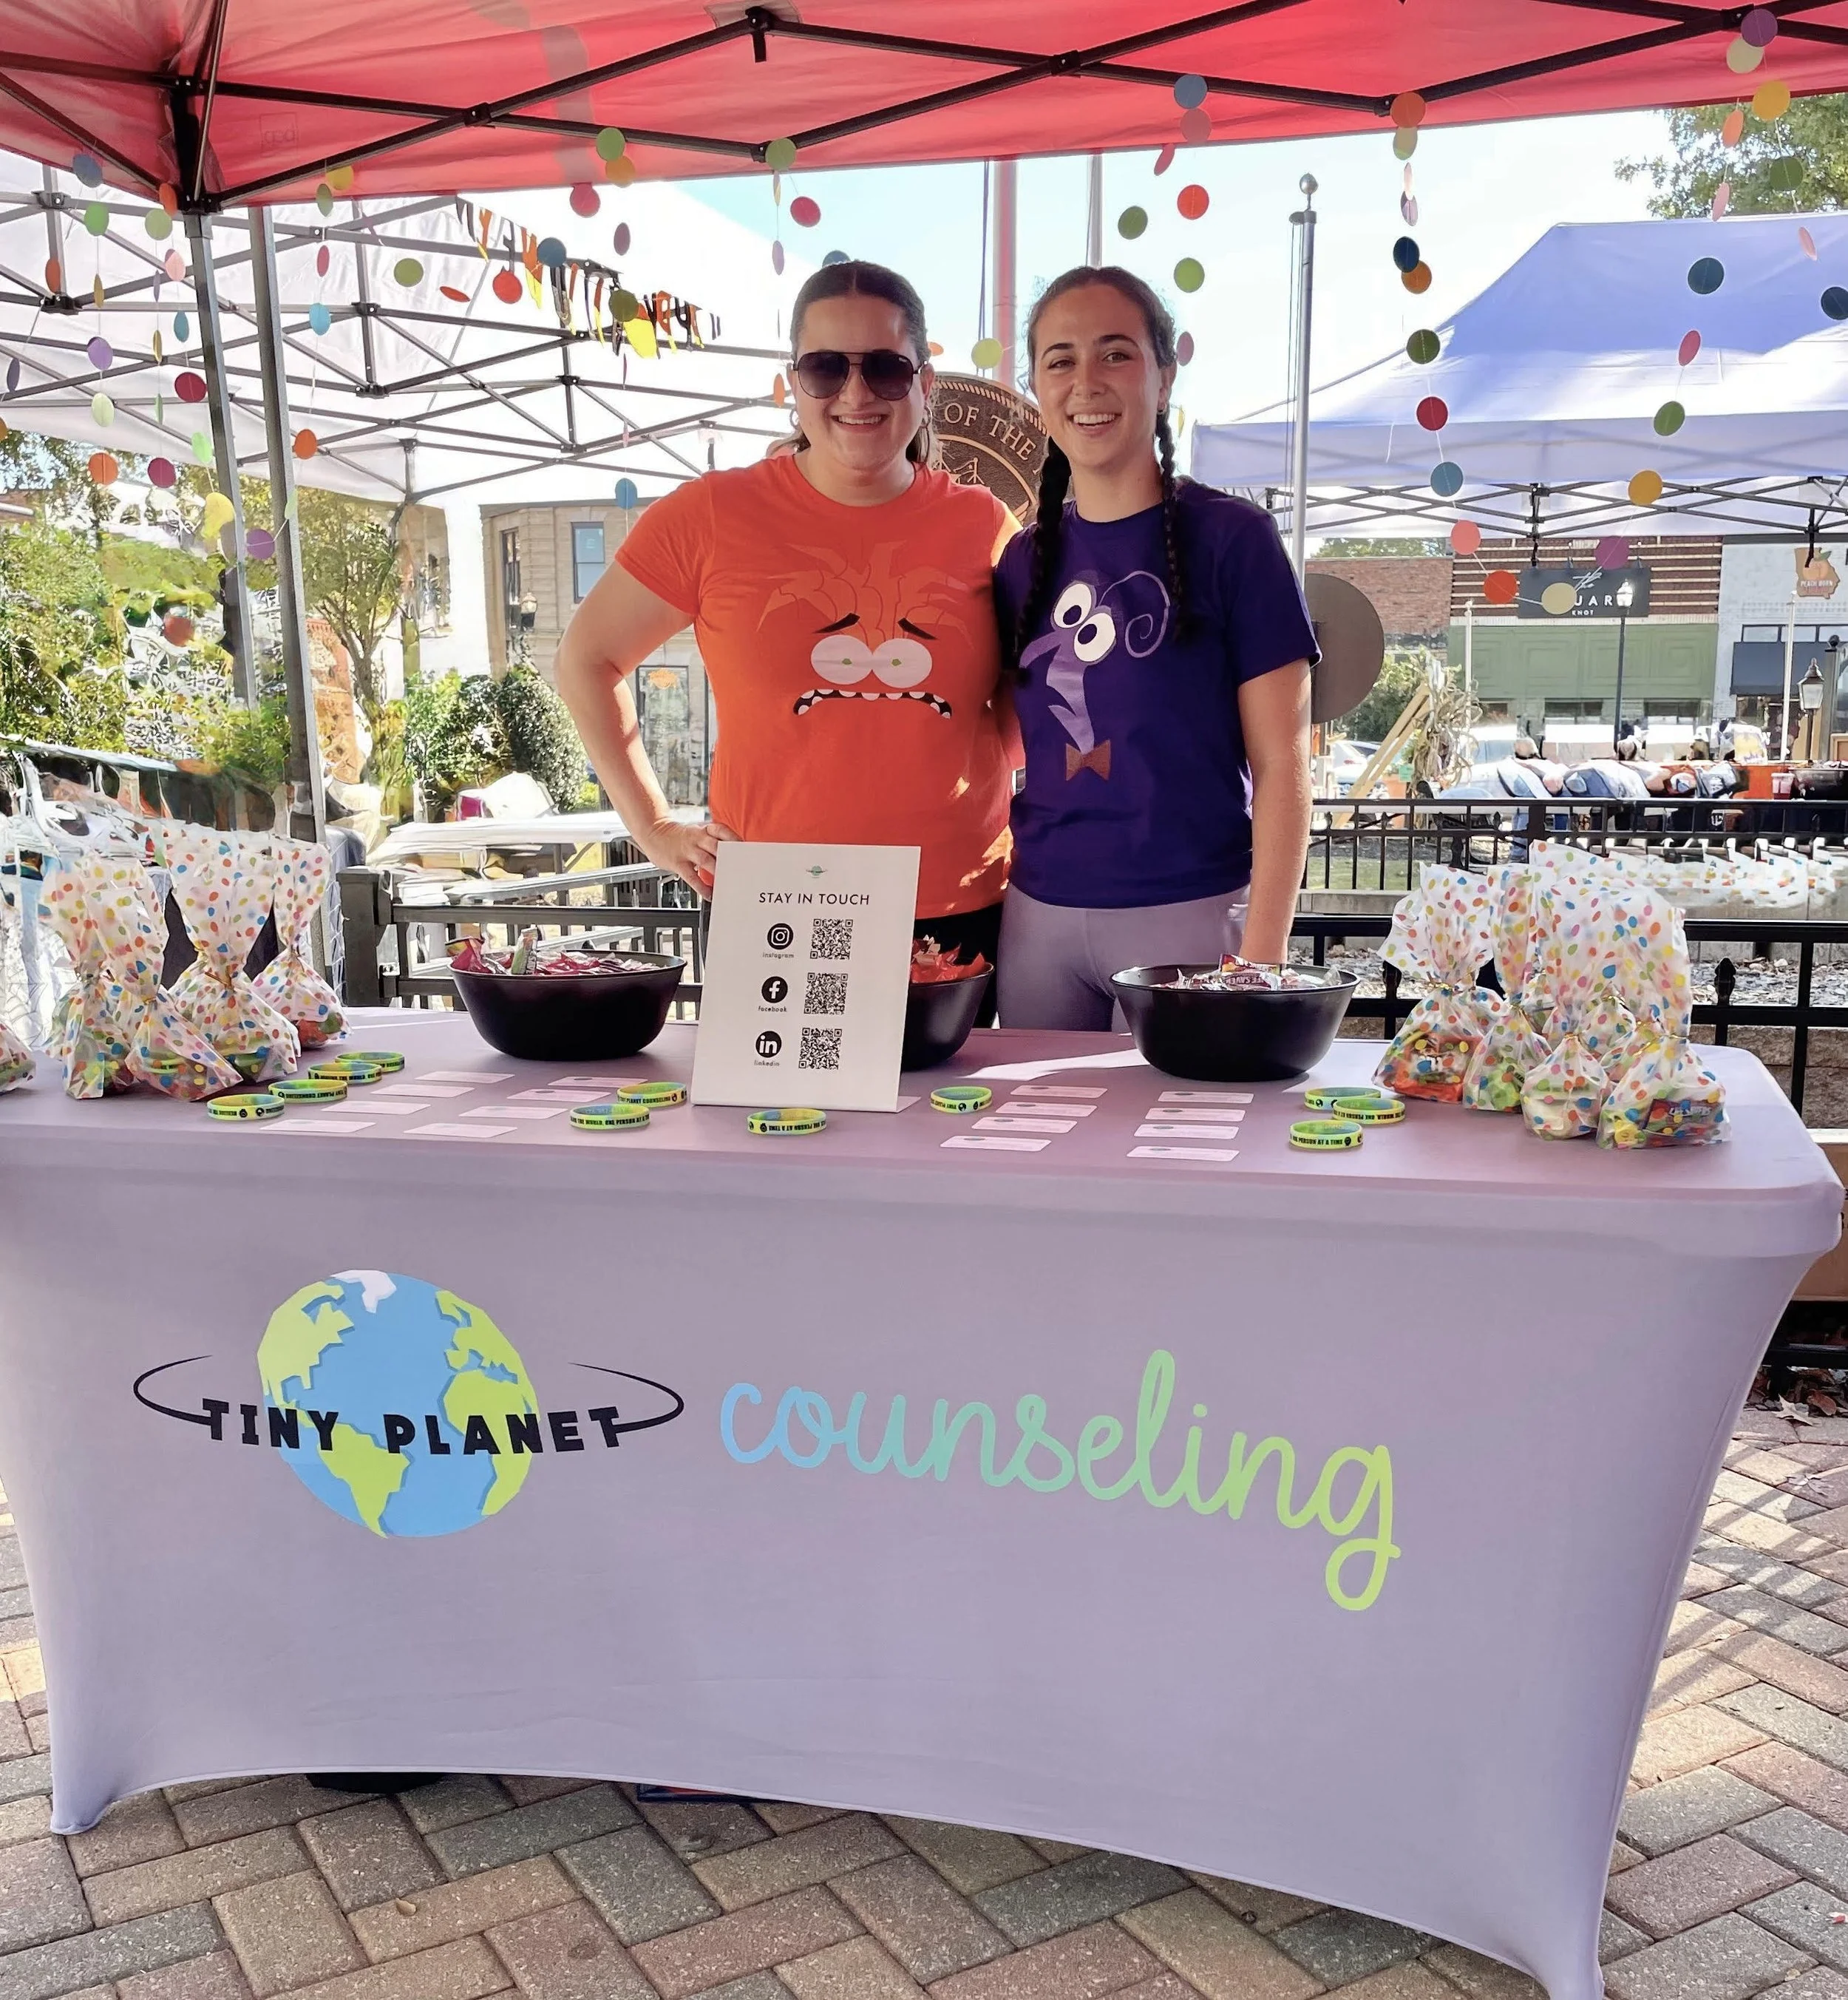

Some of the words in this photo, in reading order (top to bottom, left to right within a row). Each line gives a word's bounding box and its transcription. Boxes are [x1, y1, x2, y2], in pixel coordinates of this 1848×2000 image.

[944, 402, 979, 427] OF
[989, 415, 1036, 461] THE
[759, 892, 792, 904] STAY
[798, 893, 812, 904] IN
[818, 893, 869, 905] TOUCH
[754, 1059, 780, 1067] linkedin
[759, 1034, 778, 1054] in
[202, 1397, 340, 1451] TINY
[383, 1406, 620, 1456] PLANET
[720, 1349, 1402, 1611] counseling
